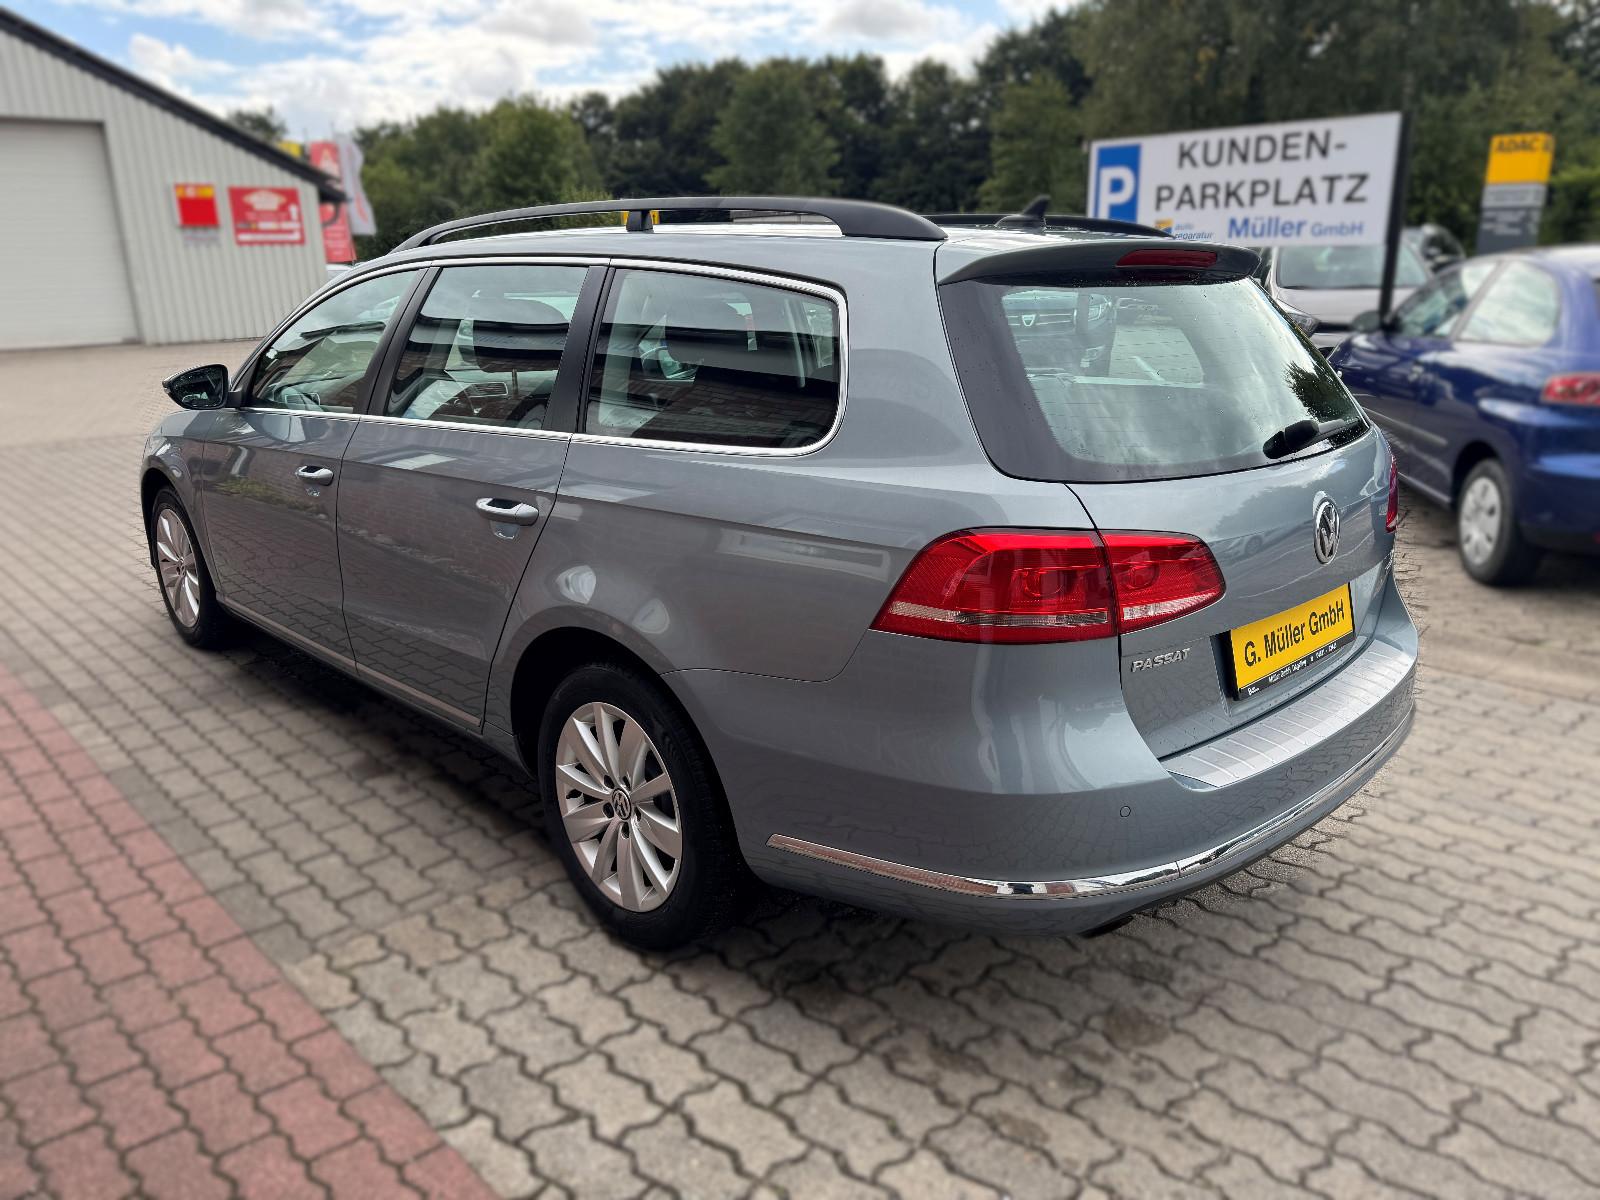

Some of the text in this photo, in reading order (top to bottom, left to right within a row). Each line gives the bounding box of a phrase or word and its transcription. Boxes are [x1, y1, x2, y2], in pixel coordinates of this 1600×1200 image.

[1177, 128, 1347, 169] KUNDEN-
[1097, 165, 1136, 219] P
[1155, 173, 1369, 212] PARKPLATZ
[1228, 215, 1363, 239] Müller GmbH
[1244, 640, 1261, 667] G.
[1263, 622, 1306, 658] Müller
[1308, 598, 1345, 636] GmbH
[1130, 647, 1191, 673] PASSAT
